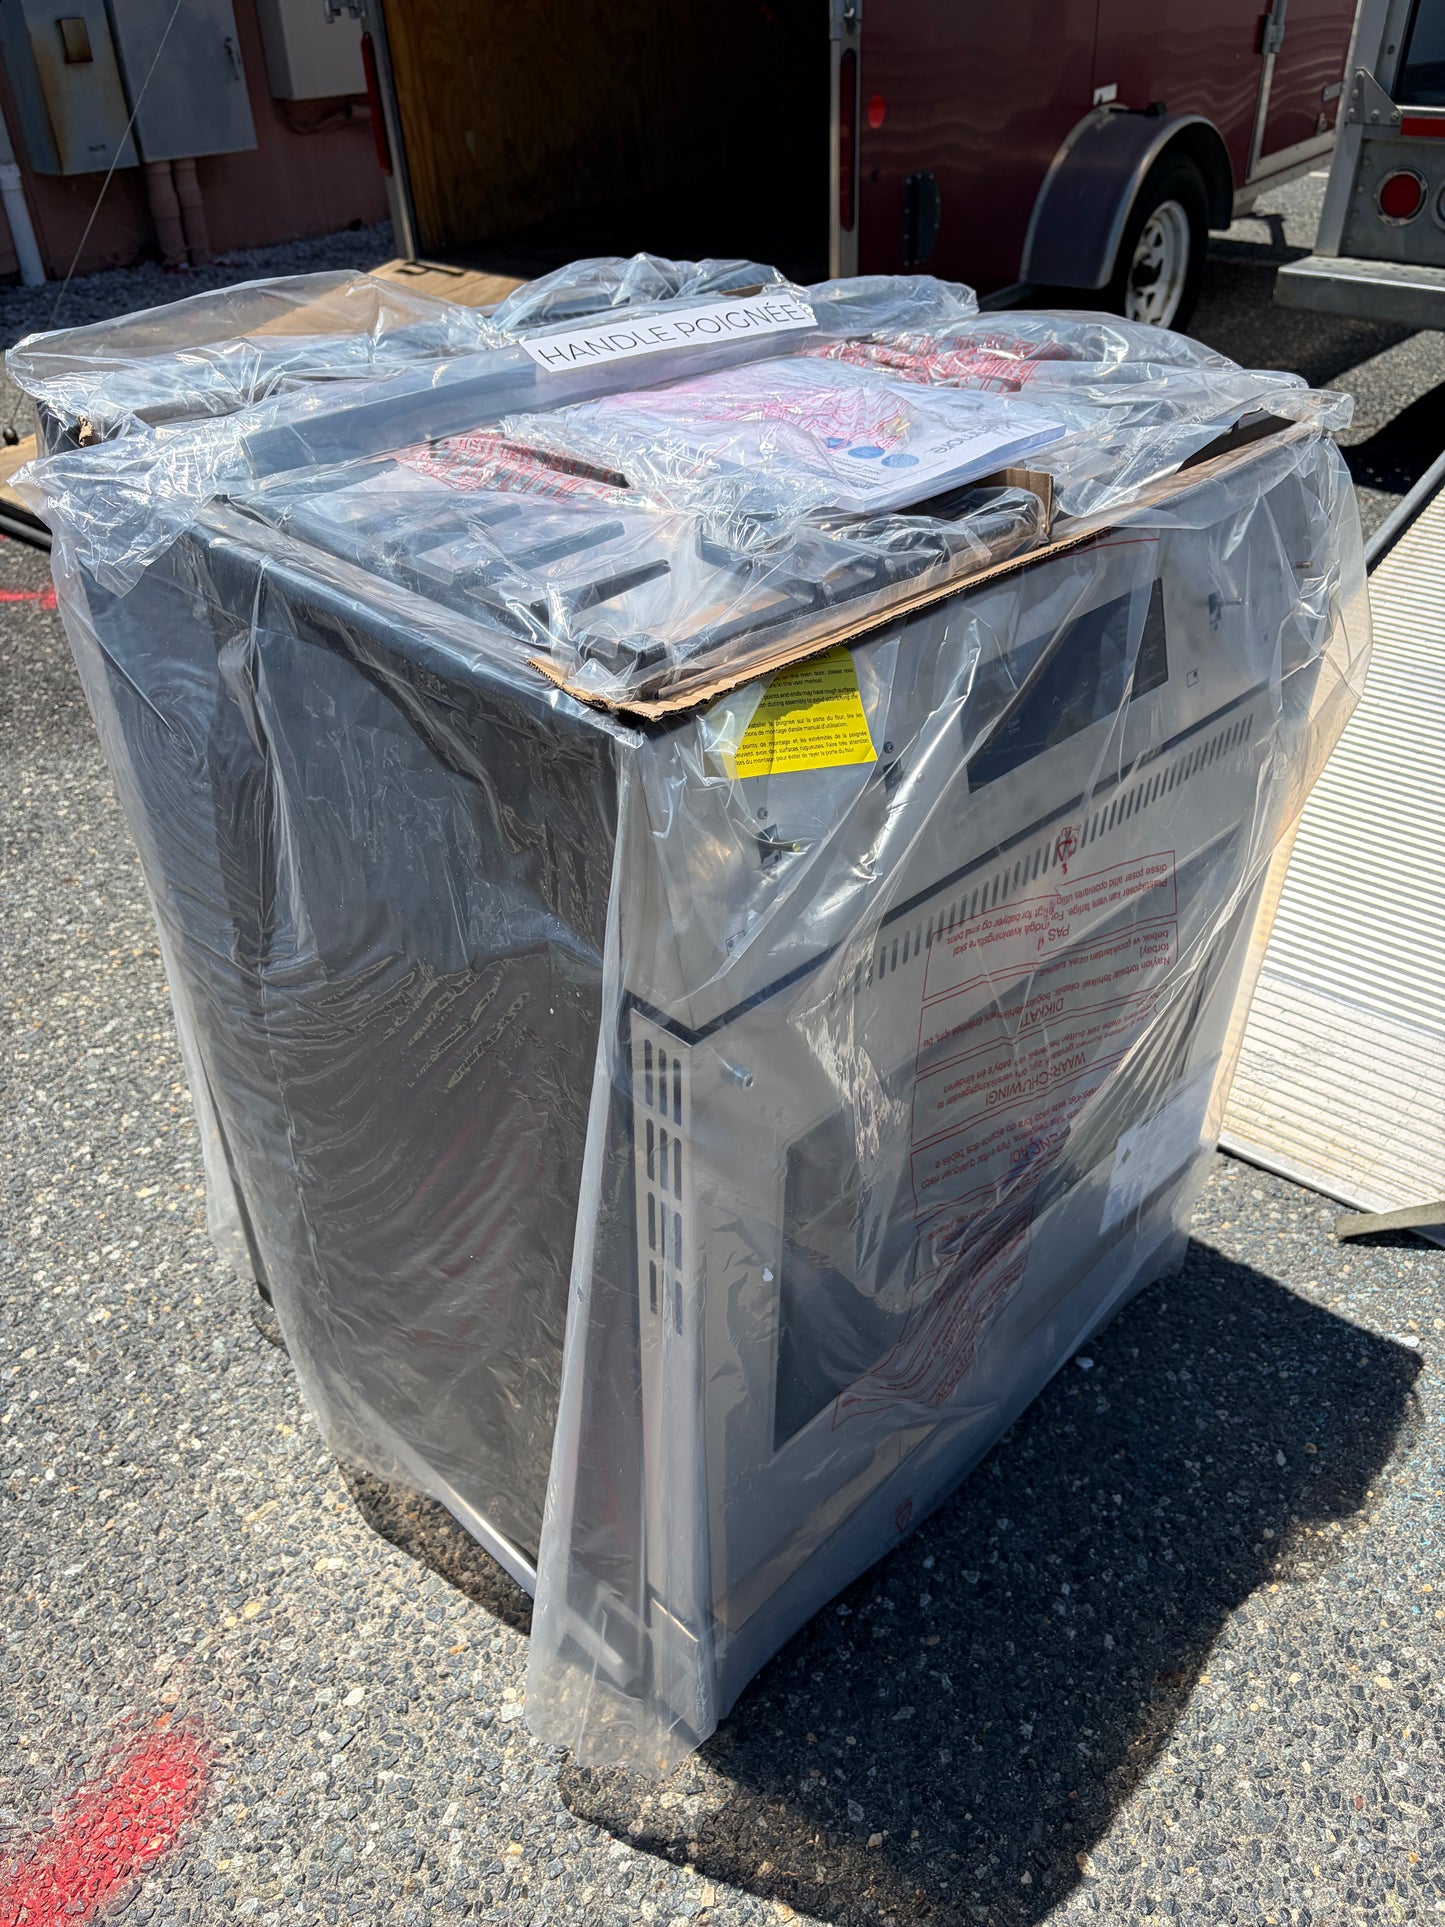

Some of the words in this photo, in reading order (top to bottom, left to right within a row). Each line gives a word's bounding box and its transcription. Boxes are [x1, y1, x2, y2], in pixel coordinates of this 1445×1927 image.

[537, 326, 677, 365] HANDLE
[674, 301, 806, 338] POIGNÉE
[769, 740, 790, 748] montage
[808, 734, 833, 742] extrémités
[754, 756, 775, 764] montage
[1145, 863, 1167, 874] disse
[1125, 869, 1143, 881] poser
[1123, 879, 1167, 897] Plastikposer
[1108, 892, 1122, 902] kan
[1048, 926, 1071, 942] PAS
[1142, 930, 1169, 942] bebek
[1069, 956, 1089, 967] uzak
[1138, 956, 1171, 969] Naylon
[943, 1074, 974, 1094] kinderen
